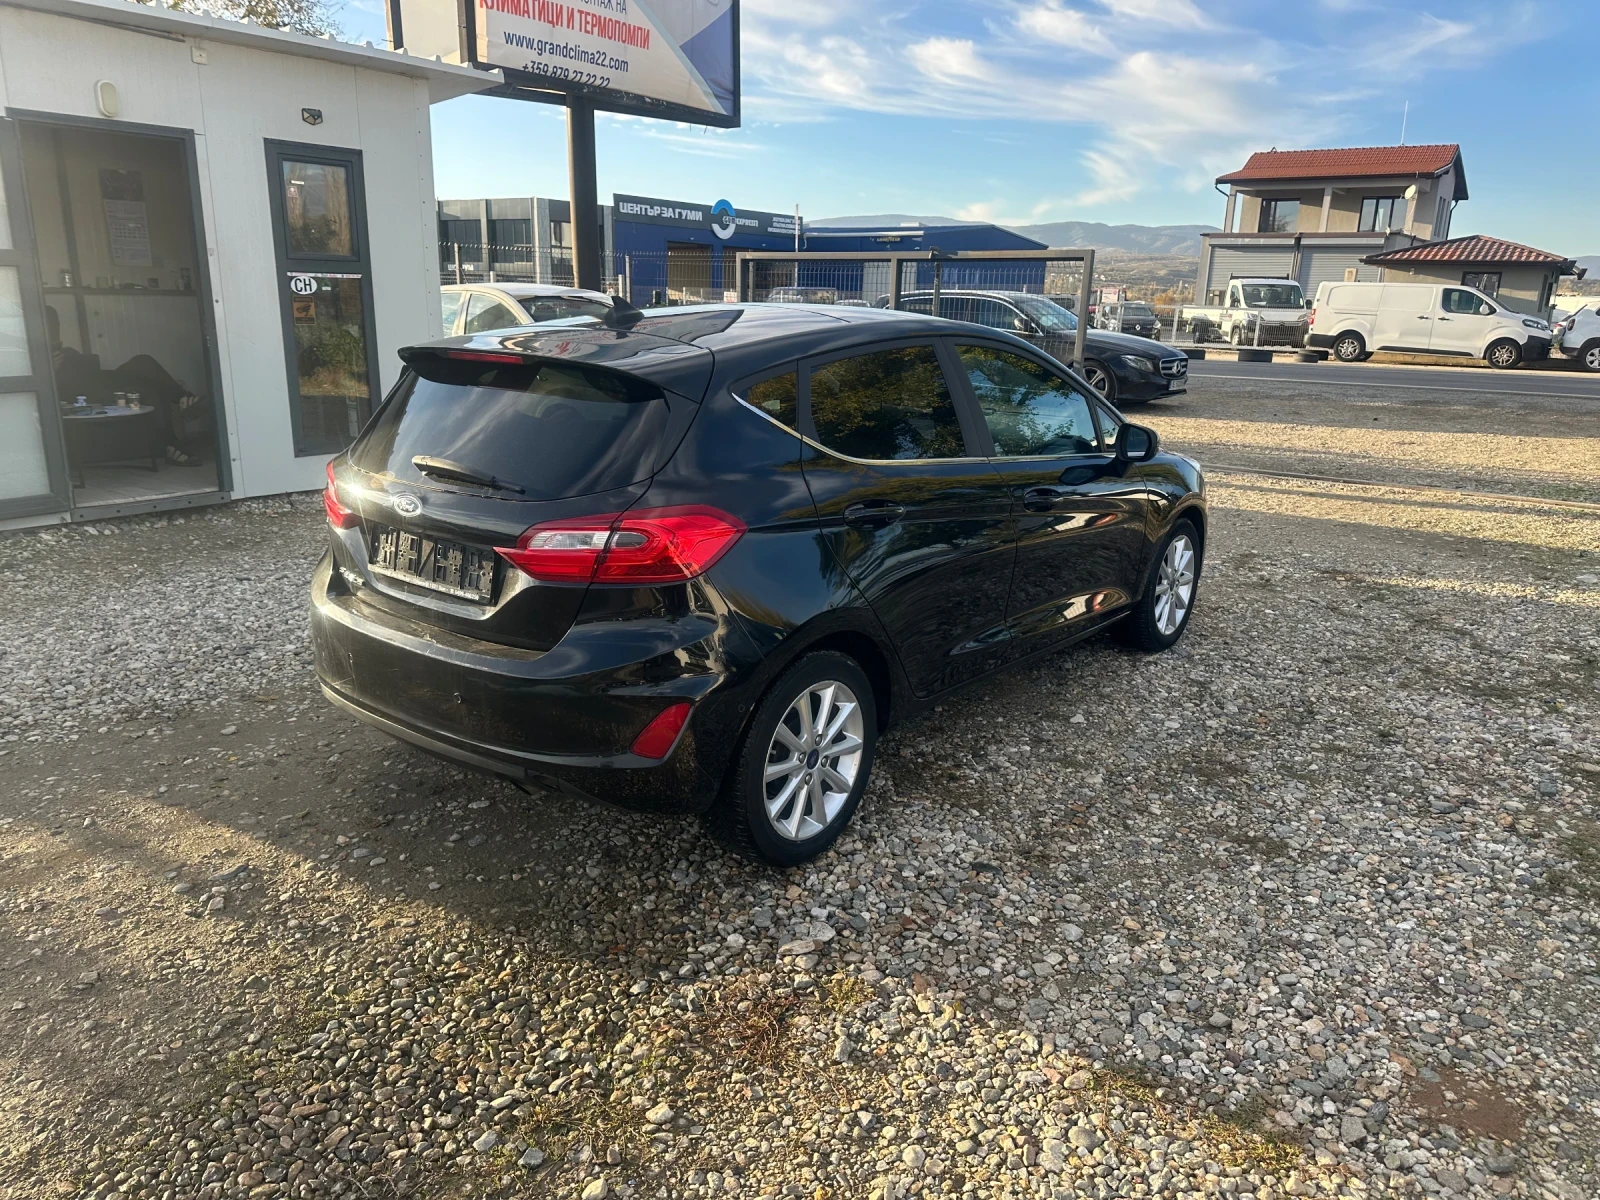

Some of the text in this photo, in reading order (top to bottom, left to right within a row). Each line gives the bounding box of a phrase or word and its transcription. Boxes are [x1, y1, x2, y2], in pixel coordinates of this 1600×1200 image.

[566, 6, 575, 30] И
[577, 8, 650, 50] ТЕРМОПОМПИ
[503, 31, 629, 72] www.grandclima22.com
[522, 60, 549, 75] +359
[551, 65, 570, 80] 879
[572, 70, 584, 83] 27
[585, 73, 597, 86] 22
[619, 201, 703, 221] ЦЕНТЪР ЗА ГУМИ
[294, 278, 313, 293] CH
